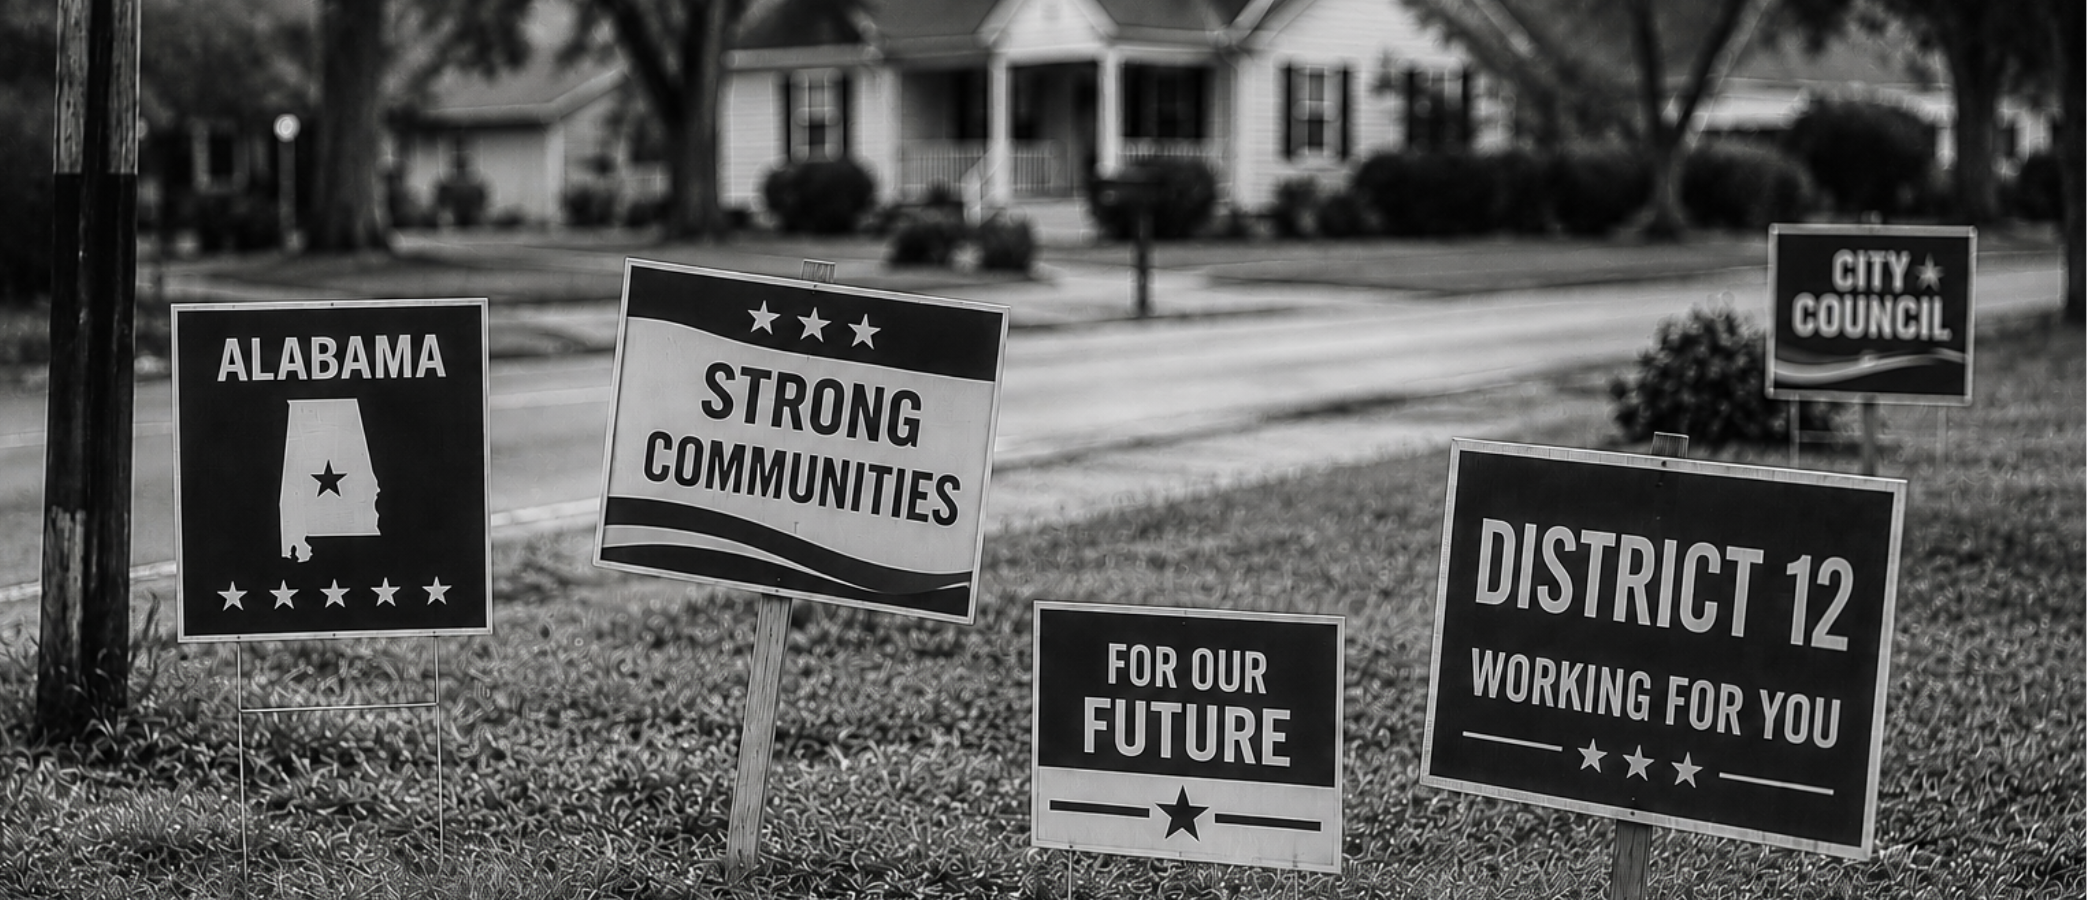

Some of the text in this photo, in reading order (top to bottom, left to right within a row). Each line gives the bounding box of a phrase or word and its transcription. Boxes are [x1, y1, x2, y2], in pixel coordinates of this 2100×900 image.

[1832, 249, 1910, 293] CITY
[1792, 293, 1951, 341] COUNCIL
[217, 334, 447, 382] ALABAMA
[702, 362, 922, 447] STRONG
[644, 431, 960, 526] COMMUNITIES
[1475, 518, 1854, 652] DISTRICT 12
[1108, 643, 1267, 695] FOR OUR
[1471, 647, 1841, 749] WORKING FOR YOU
[1083, 696, 1291, 767] FUTURE
